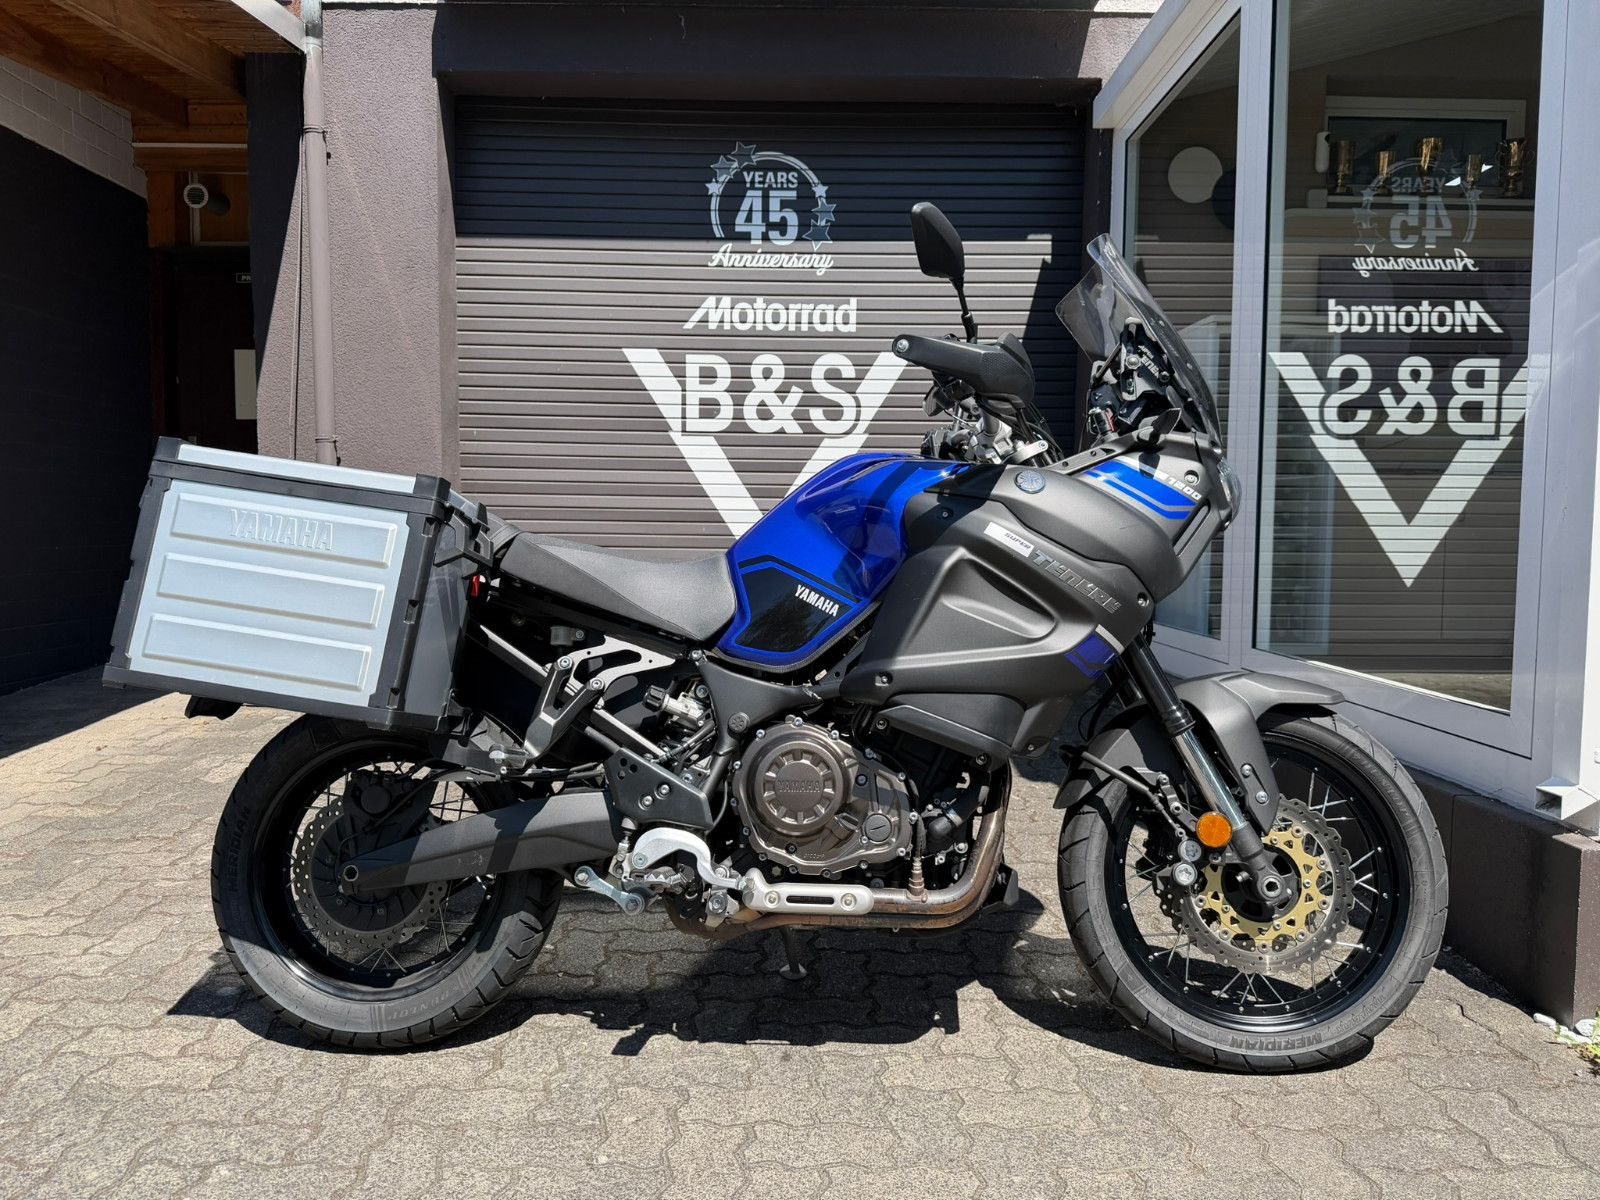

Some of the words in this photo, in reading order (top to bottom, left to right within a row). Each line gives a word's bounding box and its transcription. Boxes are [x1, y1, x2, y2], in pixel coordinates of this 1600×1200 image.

[743, 171, 799, 189] YEARS
[734, 189, 799, 246] 45
[707, 242, 834, 276] Anniversary
[682, 295, 858, 332] Motorrad
[685, 352, 858, 434] B&S
[229, 508, 334, 551] YAMAHA
[793, 584, 840, 617] YAMAHA
[1229, 1033, 1323, 1052] MERIDIAN
